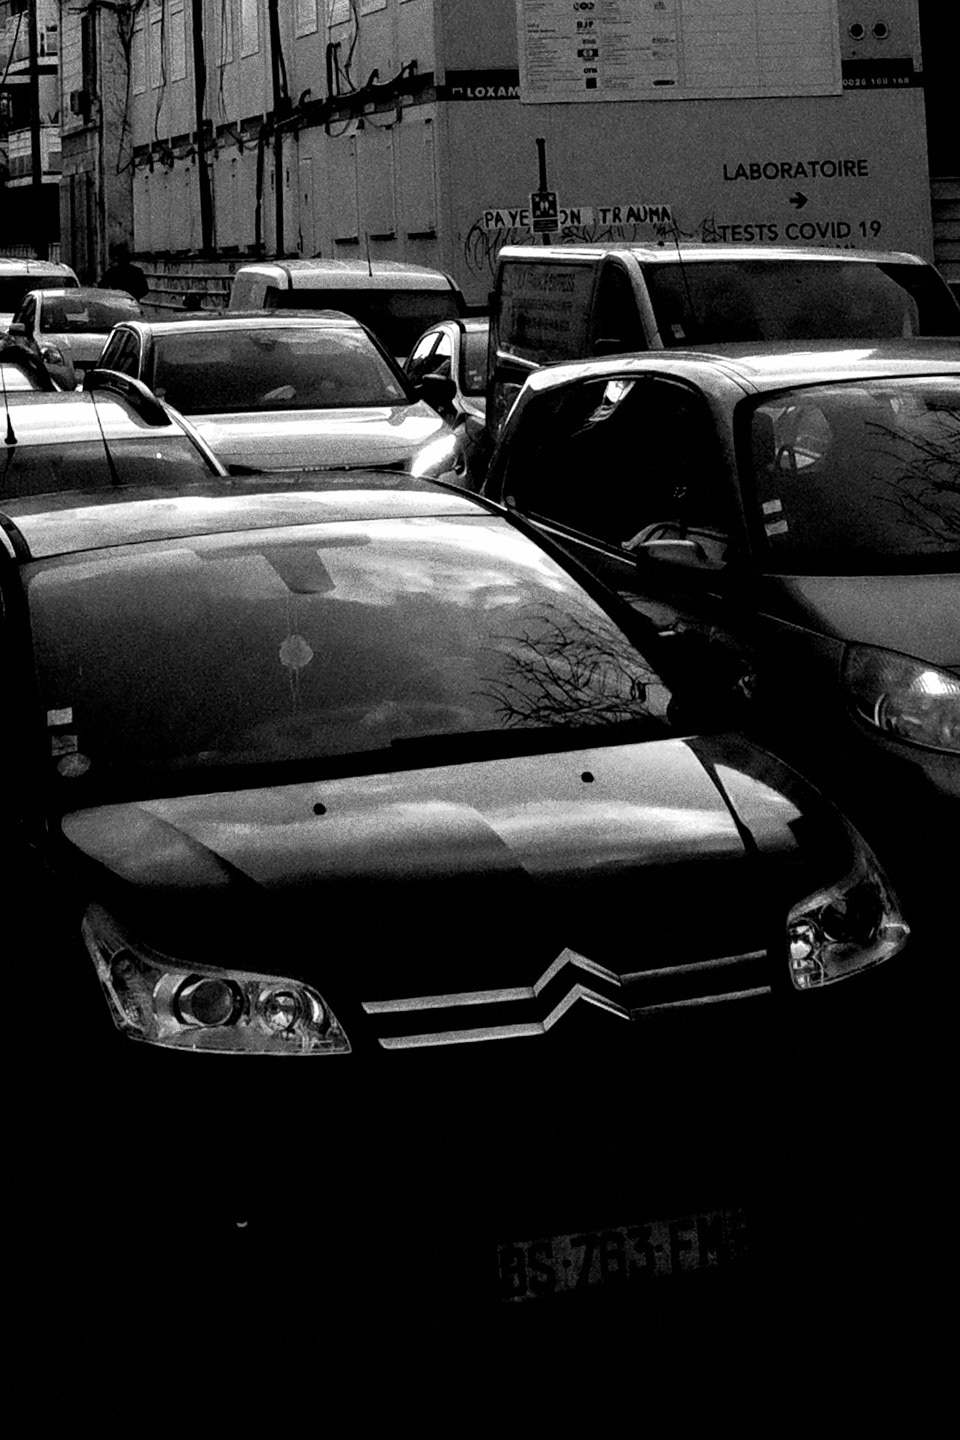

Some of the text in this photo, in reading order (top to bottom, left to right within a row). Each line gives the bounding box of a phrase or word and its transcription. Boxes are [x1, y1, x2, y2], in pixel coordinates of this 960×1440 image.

[467, 86, 520, 98] LOXAM
[723, 159, 869, 182] LABORATOIRE
[600, 205, 671, 225] TRAUMA
[718, 224, 779, 242] TESTS
[785, 221, 851, 240] COVID
[859, 220, 882, 238] 19
